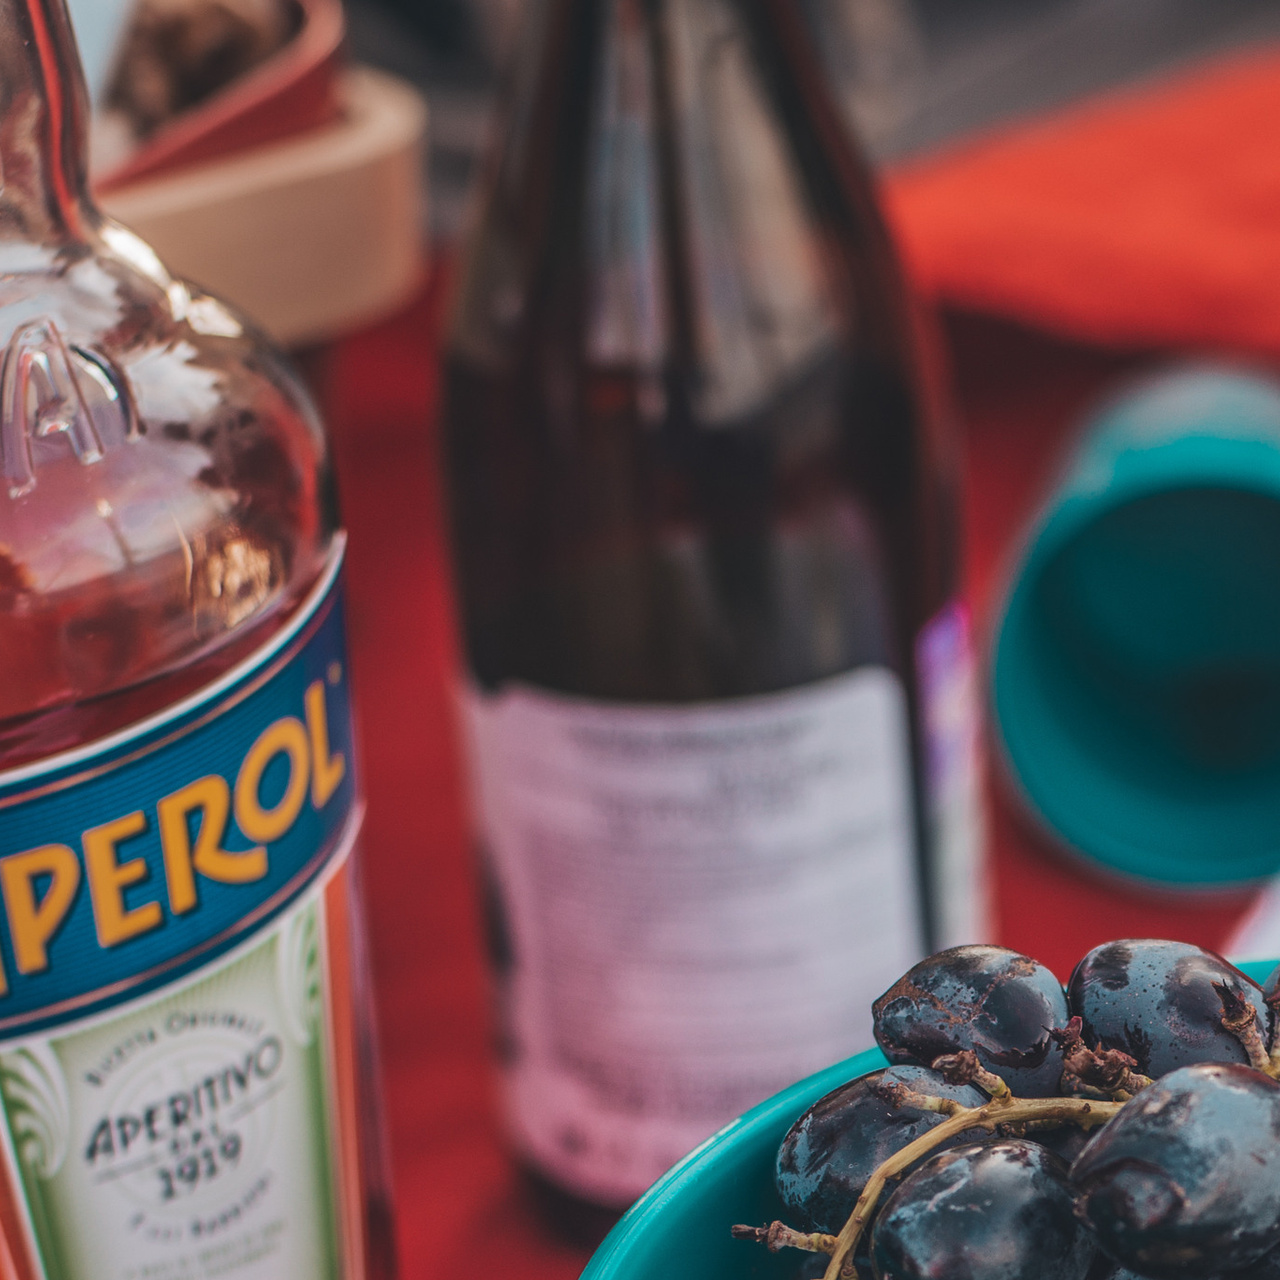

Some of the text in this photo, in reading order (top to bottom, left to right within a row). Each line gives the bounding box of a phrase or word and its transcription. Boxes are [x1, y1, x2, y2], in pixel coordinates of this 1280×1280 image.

[0, 681, 345, 996] PEROL
[84, 1035, 283, 1163] APERITIVO
[157, 1133, 242, 1201] 1919
